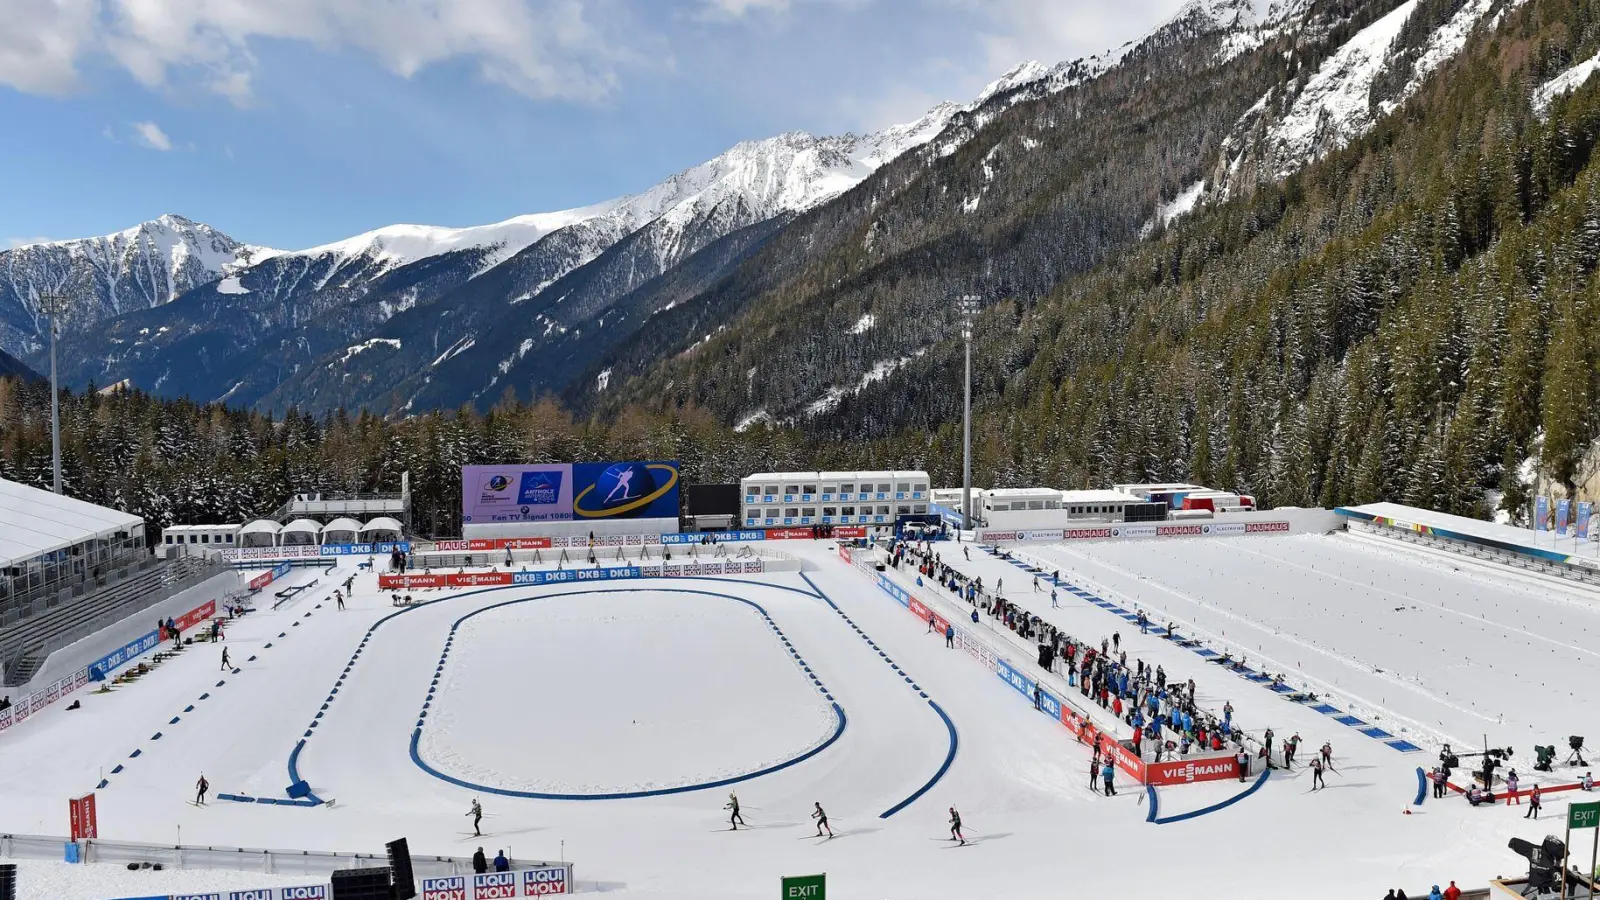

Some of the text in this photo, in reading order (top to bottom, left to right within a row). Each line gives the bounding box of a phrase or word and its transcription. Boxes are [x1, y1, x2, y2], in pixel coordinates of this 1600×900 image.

[523, 513, 548, 521] Signal
[1157, 526, 1201, 534] BAUHAUS
[1246, 523, 1288, 532] BAUHAUS
[1065, 530, 1110, 538] BAUHAUS
[322, 545, 341, 554] DKB
[350, 545, 370, 554] DKB
[389, 576, 435, 586] VIESSMANN
[456, 575, 502, 585] VIESSMANN
[514, 574, 535, 582] DKB
[143, 636, 154, 649] DKB
[127, 644, 138, 658] DKB
[108, 653, 120, 668] DKB
[1106, 745, 1139, 772] VIESSMANN
[1163, 763, 1232, 781] VIESSMANN
[1574, 810, 1596, 820] EXIT
[475, 874, 513, 886] LIQUI
[525, 870, 563, 882] LIQUI
[425, 878, 463, 891] LIQUI
[525, 882, 563, 895] MOLY
[284, 886, 323, 899] LIQUI
[425, 890, 464, 900] MOLY
[475, 886, 513, 899] MOLY
[789, 885, 818, 897] EXIT
